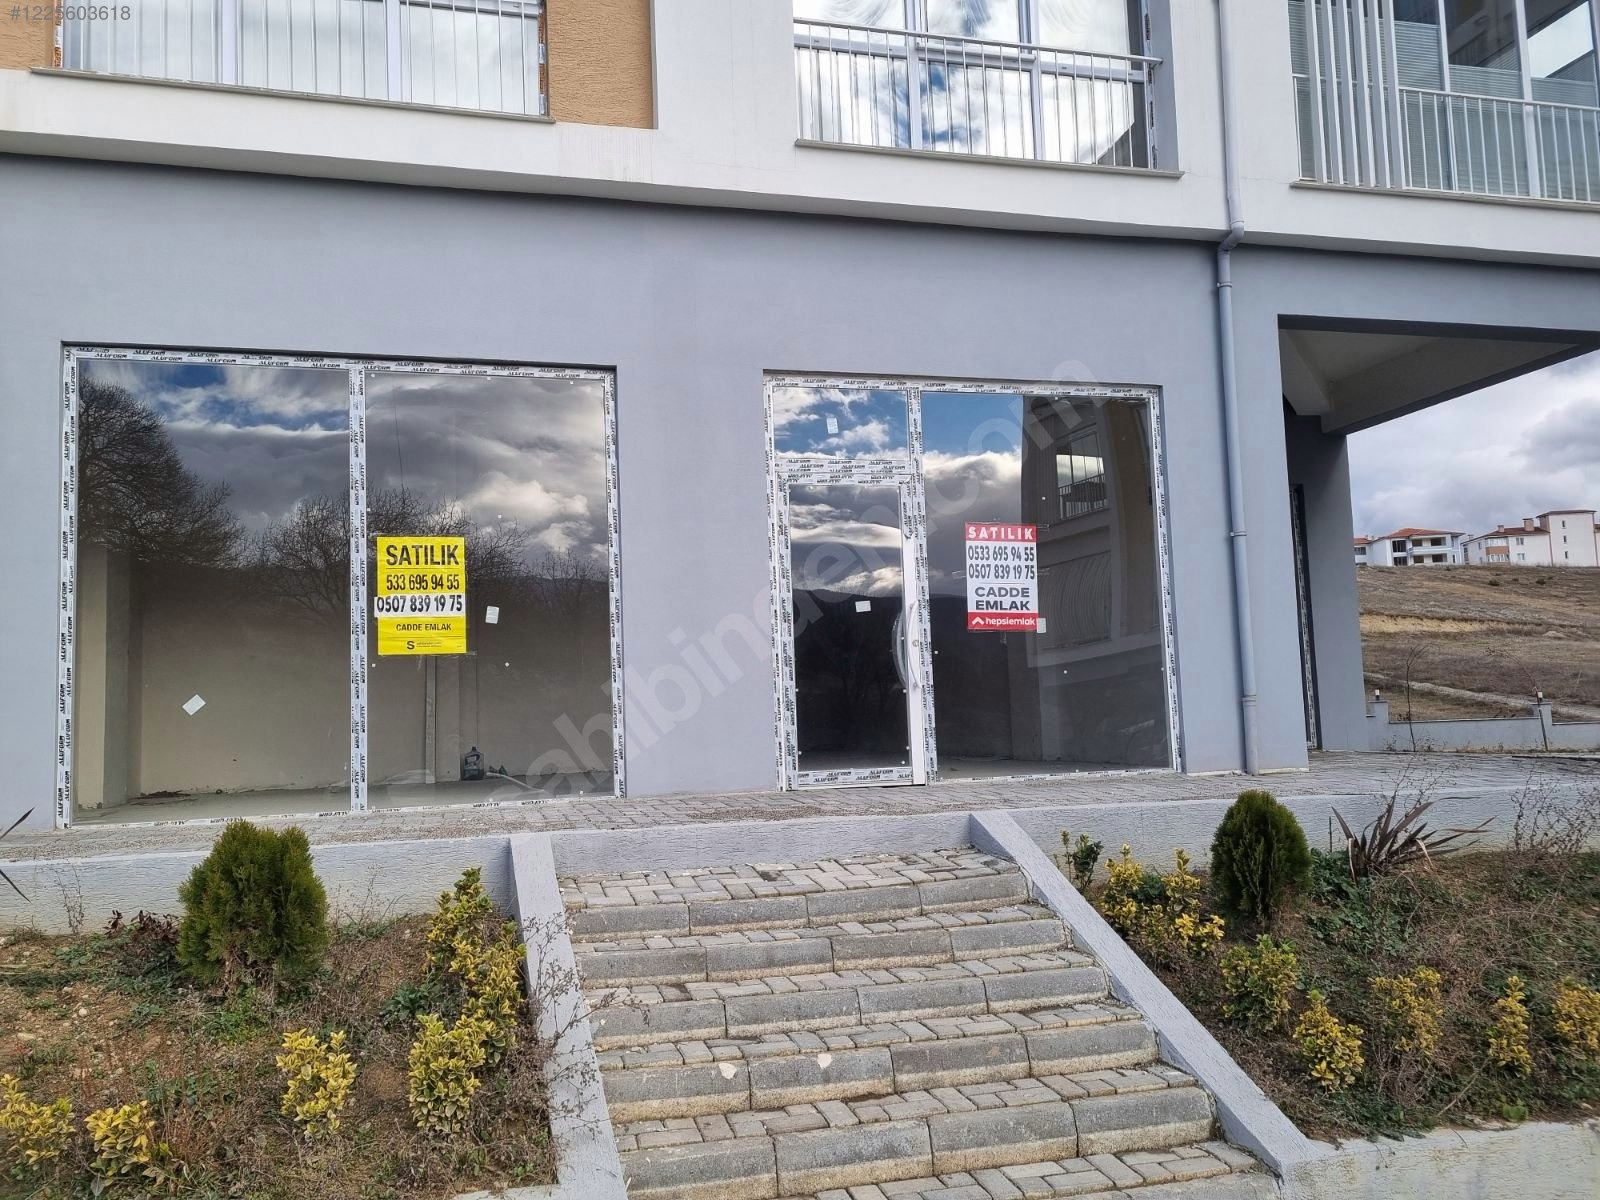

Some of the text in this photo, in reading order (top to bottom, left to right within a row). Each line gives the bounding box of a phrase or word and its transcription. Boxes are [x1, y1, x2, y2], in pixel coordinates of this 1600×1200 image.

[968, 527, 1033, 540] SATILIK
[386, 544, 460, 566] SATILIK
[968, 546, 1034, 562] 0533 695 94 55
[968, 564, 1034, 580] 0507 839 19 75
[386, 574, 460, 590] 533 695 94 55
[975, 586, 1030, 598] CADDE
[377, 595, 462, 612] 0507 839 19 75
[976, 600, 1030, 610] EMLAK
[986, 617, 1036, 626] hepsiemlak
